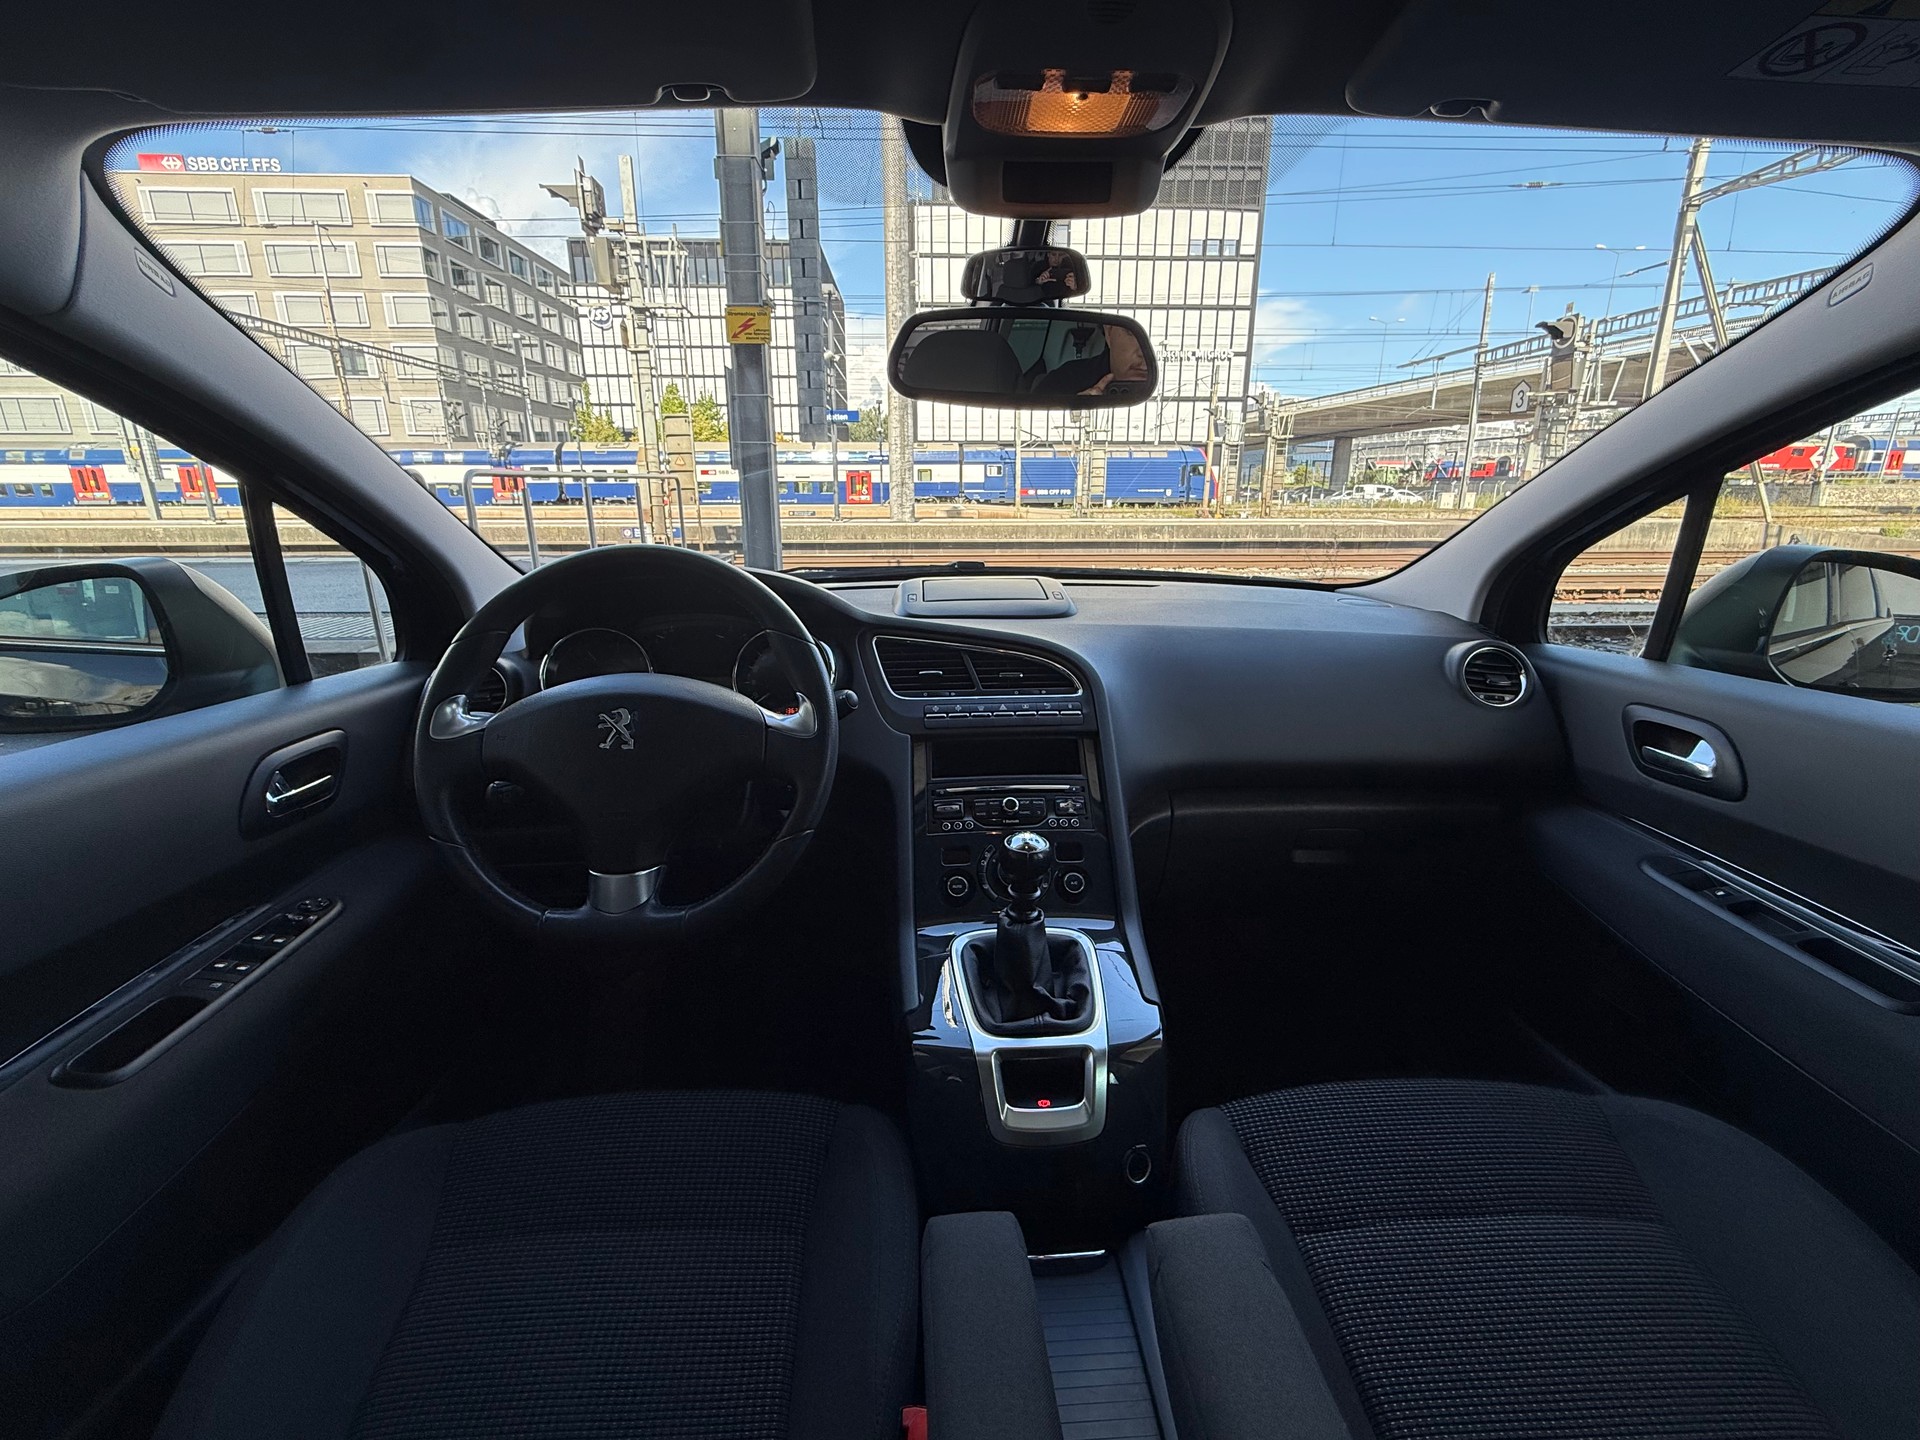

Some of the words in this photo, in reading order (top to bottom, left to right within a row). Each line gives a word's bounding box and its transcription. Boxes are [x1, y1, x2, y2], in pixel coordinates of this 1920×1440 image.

[187, 156, 219, 171] SBB
[220, 157, 249, 171] CFF
[251, 157, 282, 172] FFS
[1832, 270, 1870, 299] AIRBAG
[1515, 389, 1525, 409] 3
